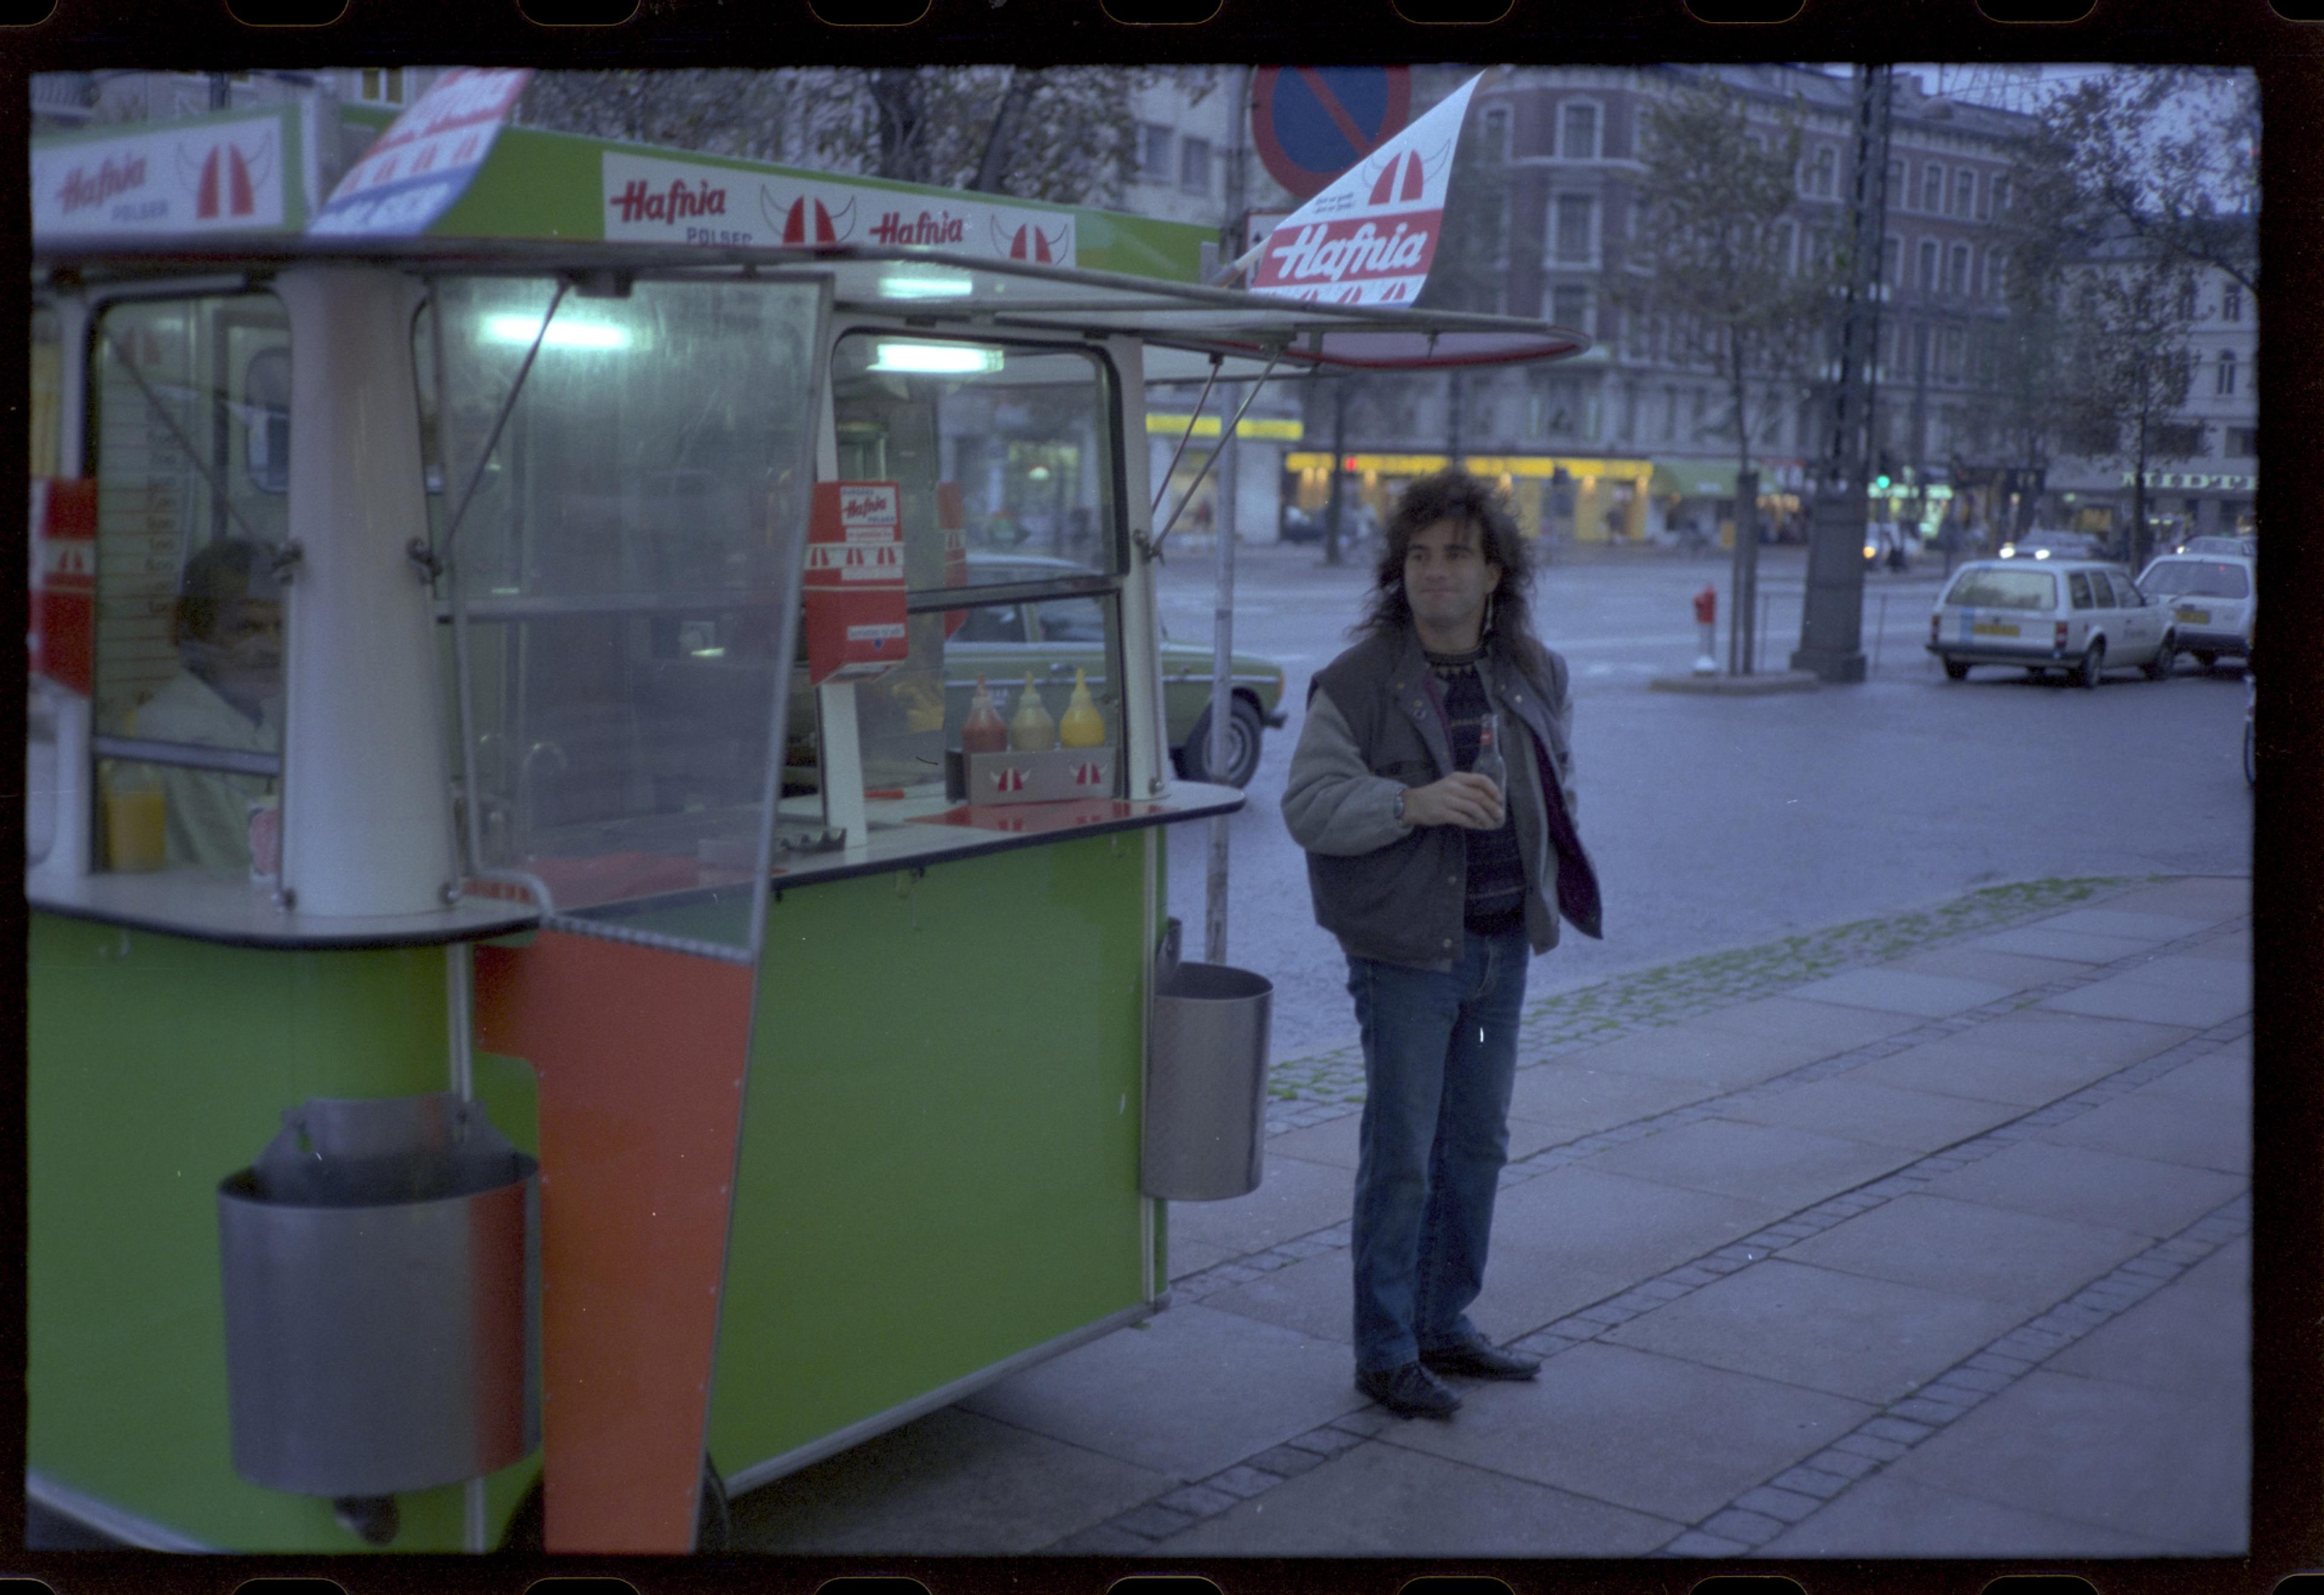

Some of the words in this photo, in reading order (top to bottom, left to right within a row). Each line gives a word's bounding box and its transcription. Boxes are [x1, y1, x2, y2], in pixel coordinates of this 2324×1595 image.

[55, 154, 146, 213] Hafnia
[610, 178, 725, 225] Hafnia
[869, 209, 963, 244] Hafnia
[1272, 221, 1428, 282] Hafnia
[843, 495, 887, 519] Hafnia
